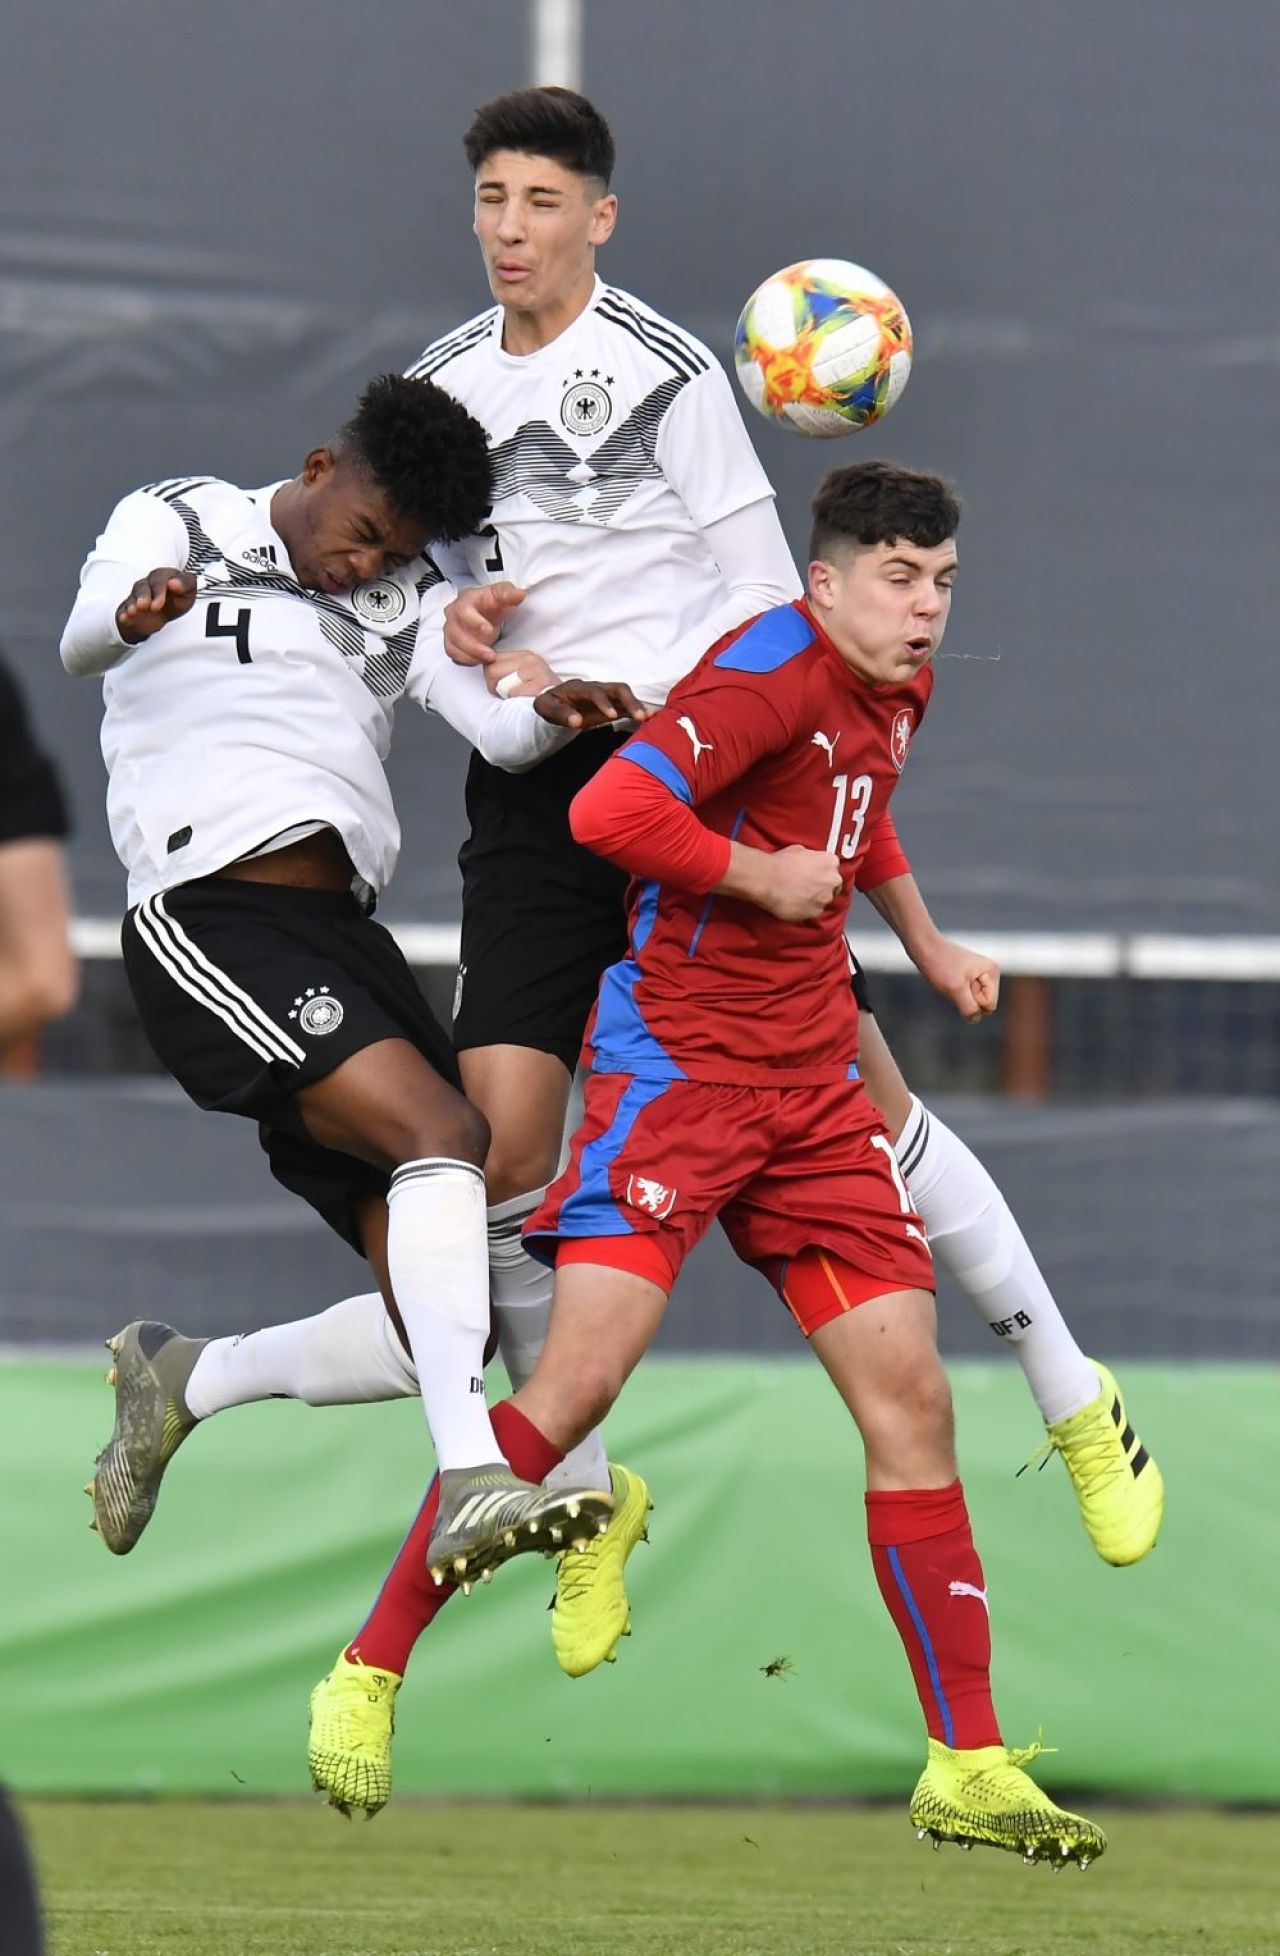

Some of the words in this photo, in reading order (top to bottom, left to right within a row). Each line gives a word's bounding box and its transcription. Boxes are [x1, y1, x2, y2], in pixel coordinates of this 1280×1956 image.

[205, 602, 253, 664] 4
[826, 774, 873, 859] 13
[870, 1135, 918, 1215] 1
[989, 1310, 1032, 1337] DFB
